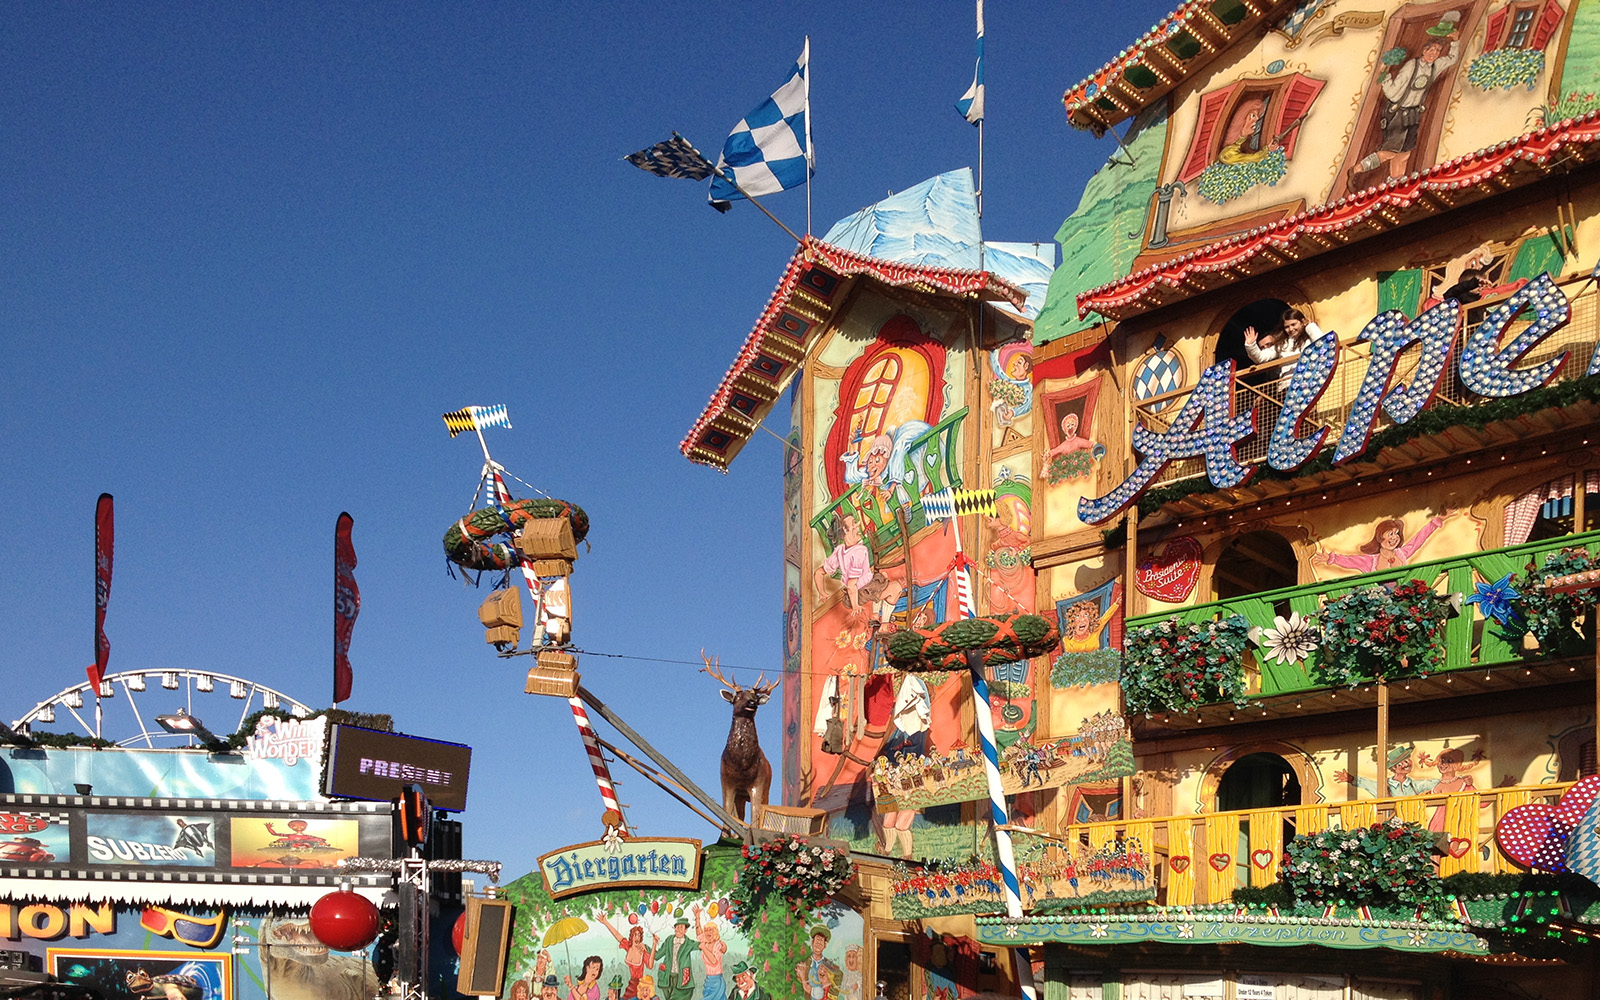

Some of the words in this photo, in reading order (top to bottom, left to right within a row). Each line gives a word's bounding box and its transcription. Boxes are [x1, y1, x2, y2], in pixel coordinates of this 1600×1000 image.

[1338, 15, 1370, 26] Servus
[1076, 252, 1600, 526] Alpe
[1156, 568, 1184, 588] Suite
[360, 758, 453, 786] PRESENT
[87, 836, 188, 861] SUBZERO
[546, 850, 687, 891] Biergarten
[1201, 922, 1348, 941] Rezeption
